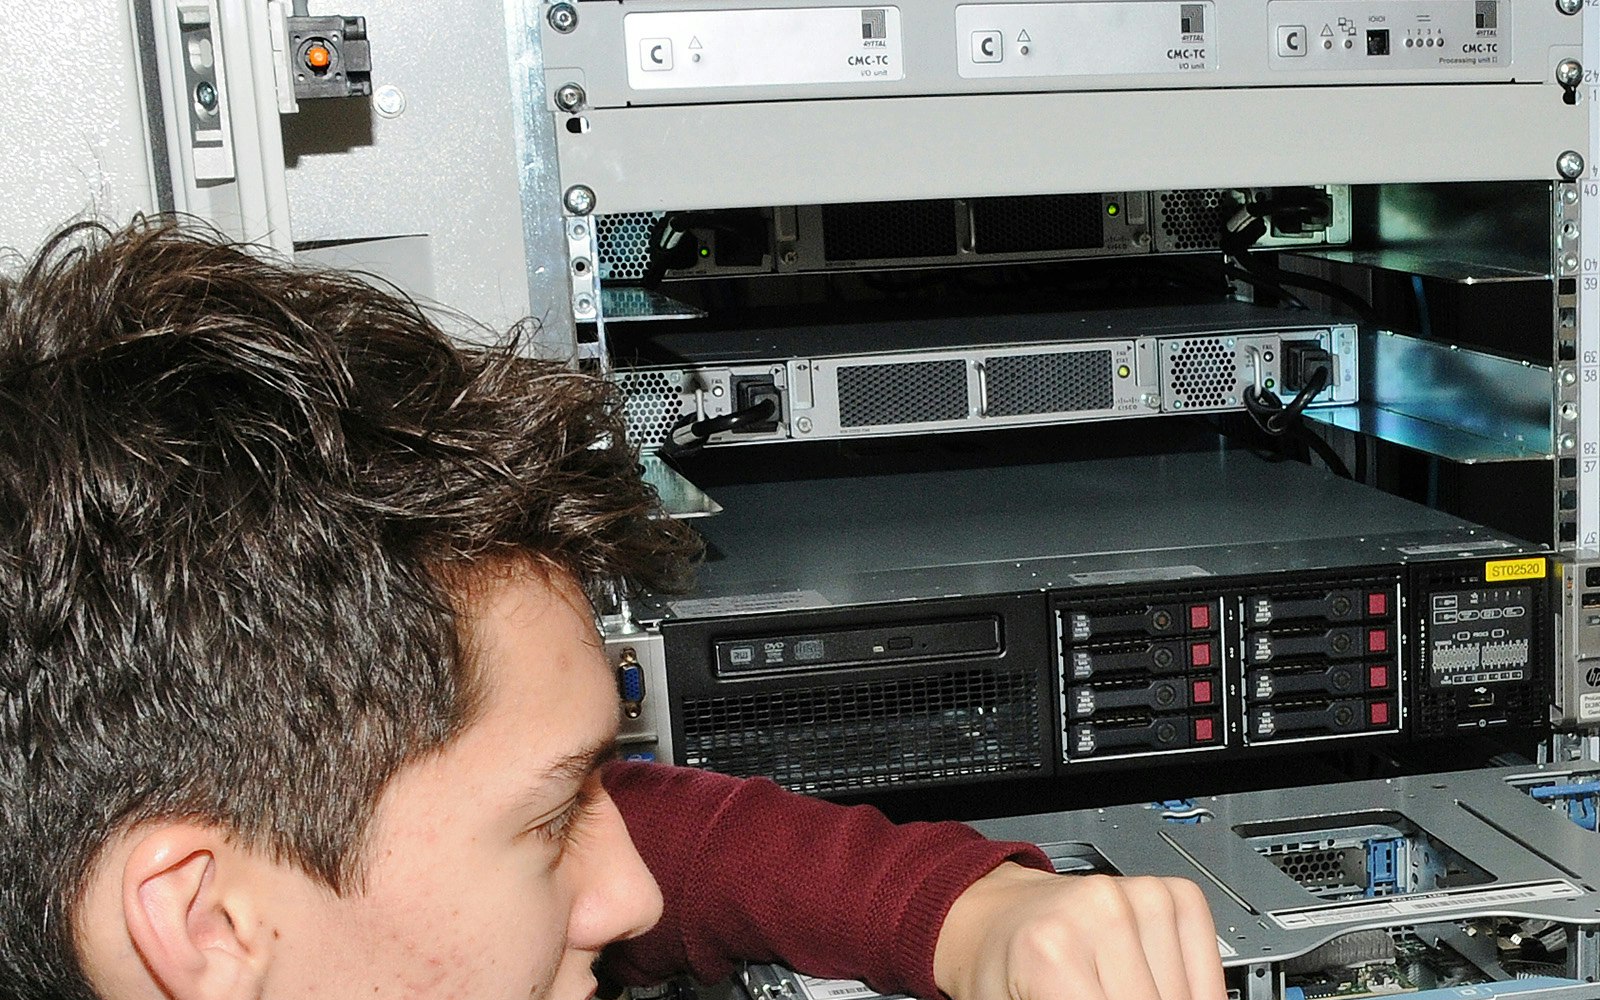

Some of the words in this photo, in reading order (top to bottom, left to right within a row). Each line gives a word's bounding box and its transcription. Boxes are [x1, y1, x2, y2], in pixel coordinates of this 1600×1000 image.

[1167, 49, 1205, 60] CMC-TC
[1463, 44, 1497, 53] CMC-TC
[848, 55, 889, 66] CMC-TC
[1439, 57, 1476, 65] Processing
[1584, 184, 1598, 197] 40
[1584, 259, 1598, 271] 40
[1584, 278, 1598, 290] 39
[1584, 351, 1598, 363] 39
[1584, 369, 1598, 382] 38
[1584, 442, 1598, 455] 38
[1584, 460, 1597, 473] 37
[1584, 531, 1597, 544] 37
[1492, 563, 1540, 577] ST02520
